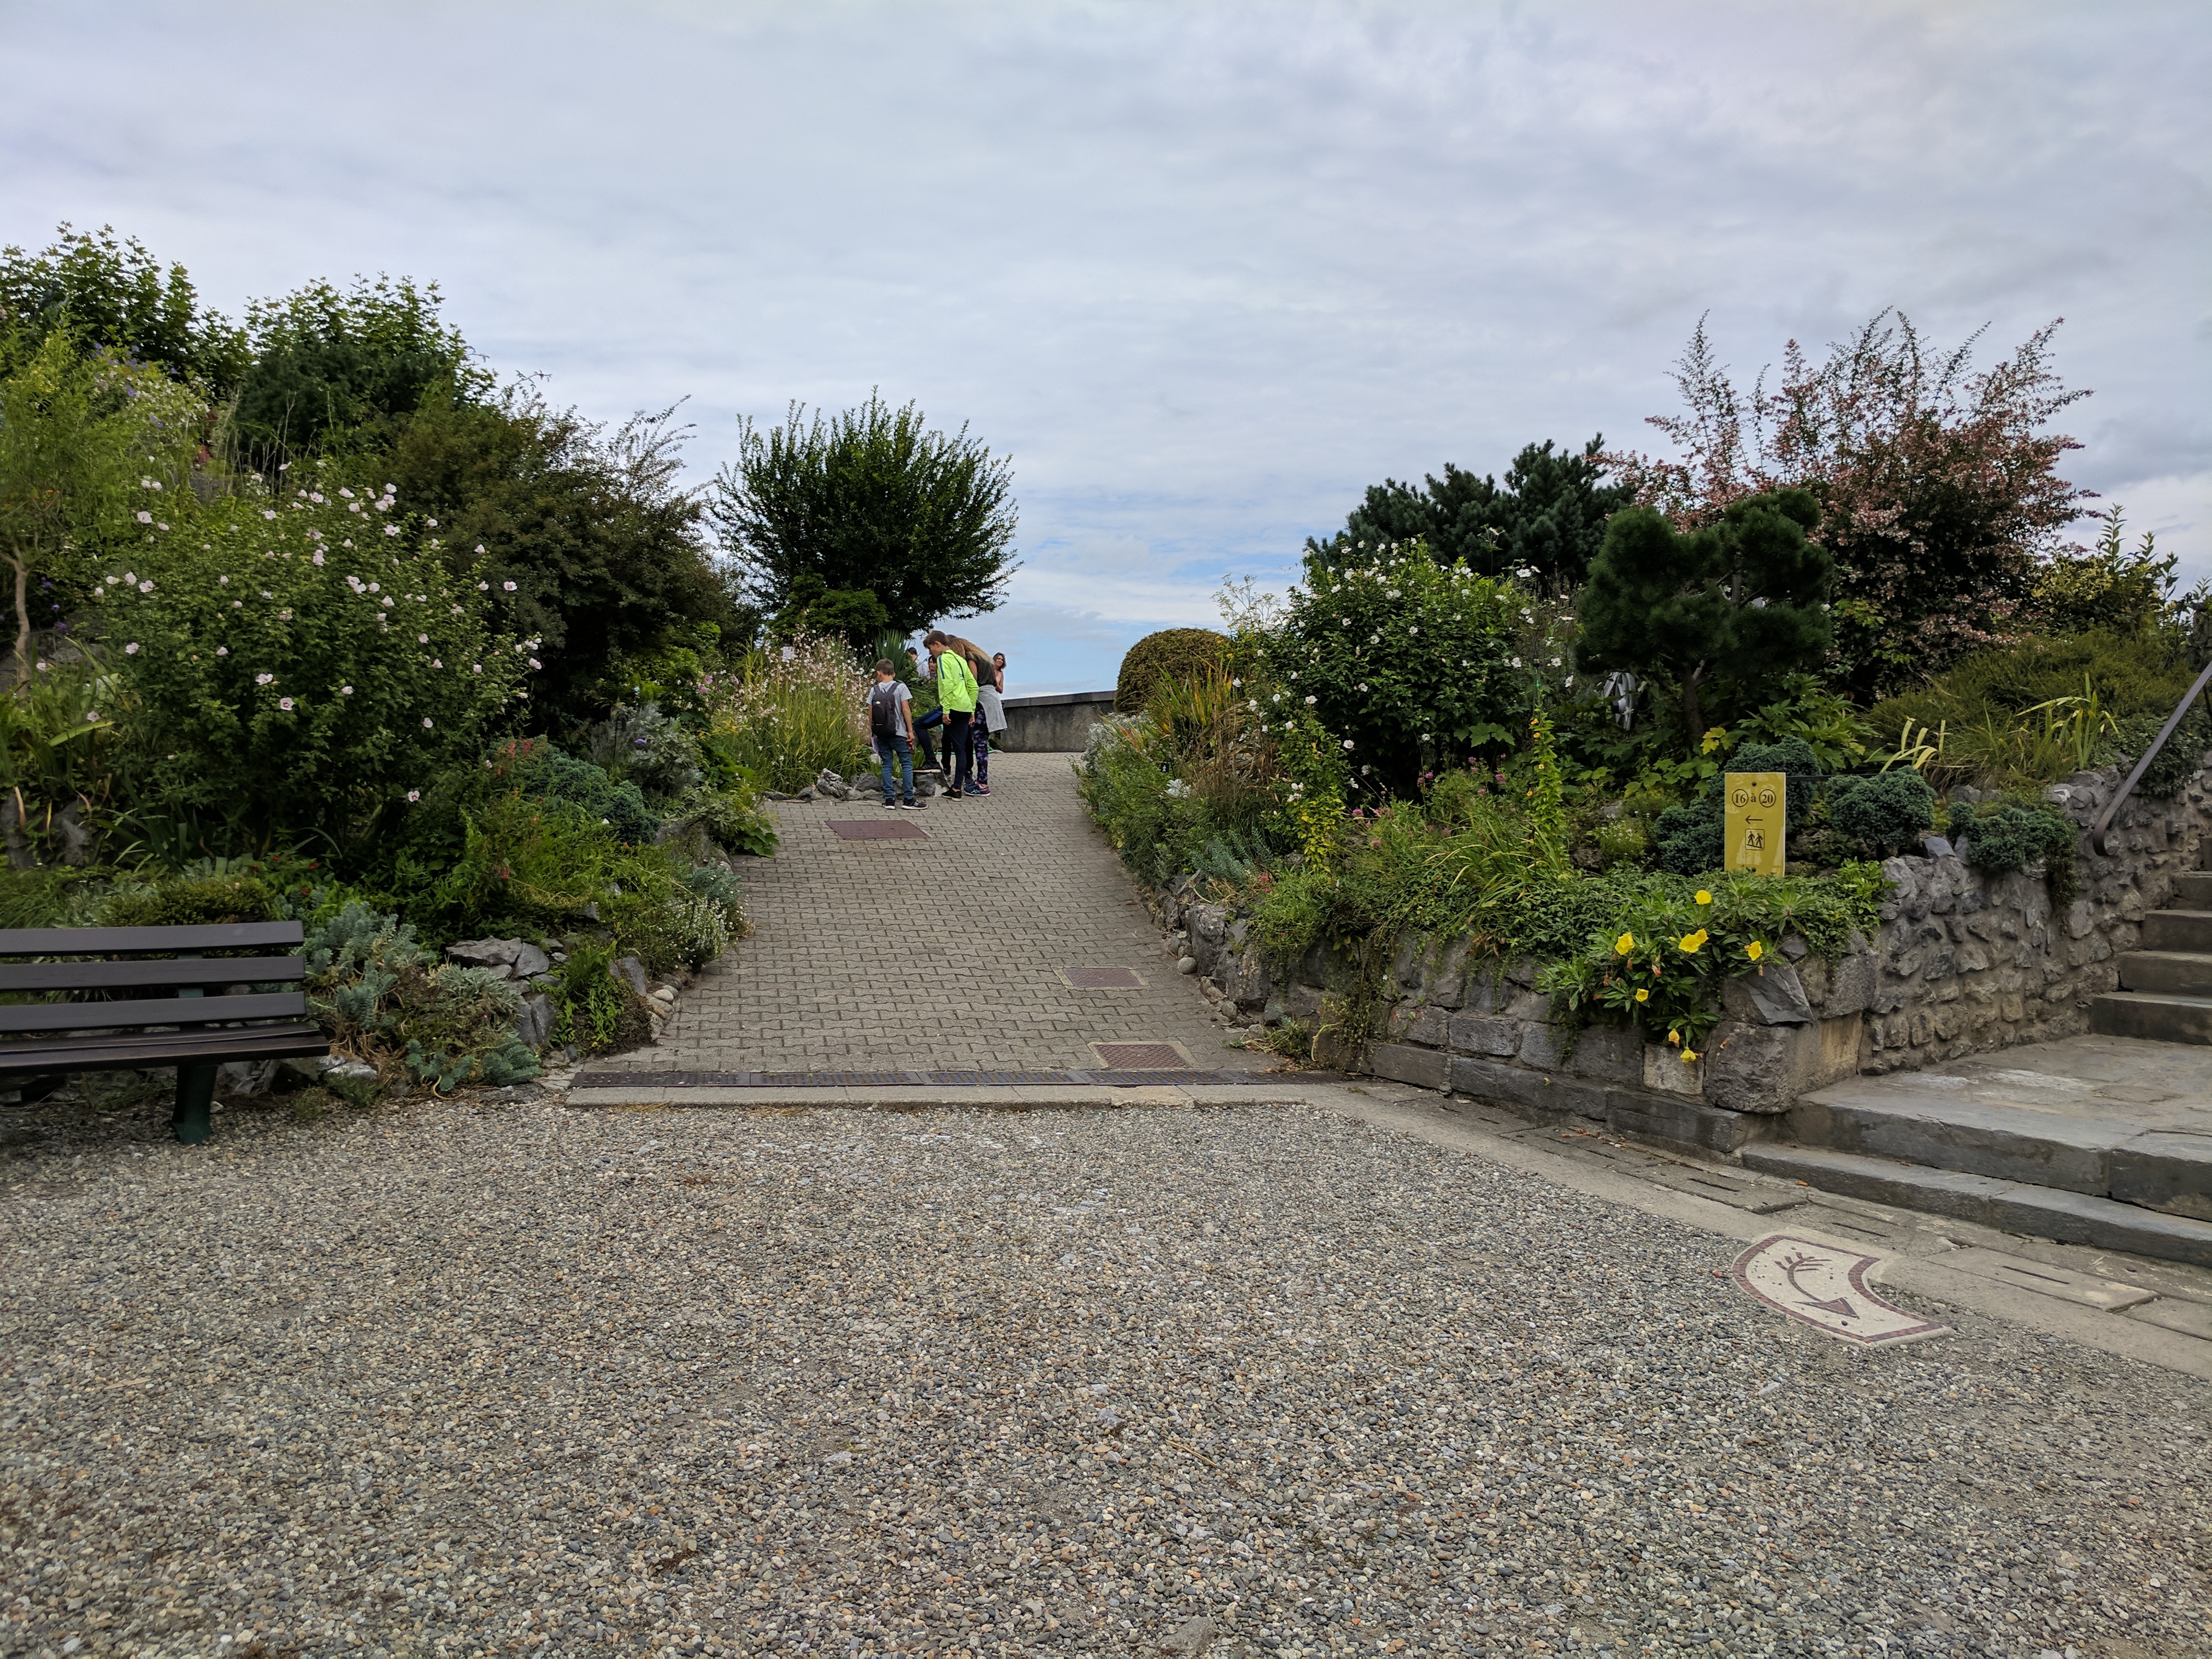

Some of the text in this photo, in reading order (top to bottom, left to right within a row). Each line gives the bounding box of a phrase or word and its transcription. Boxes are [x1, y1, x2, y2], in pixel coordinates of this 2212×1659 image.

[1734, 793, 1773, 803] 16 à 20
